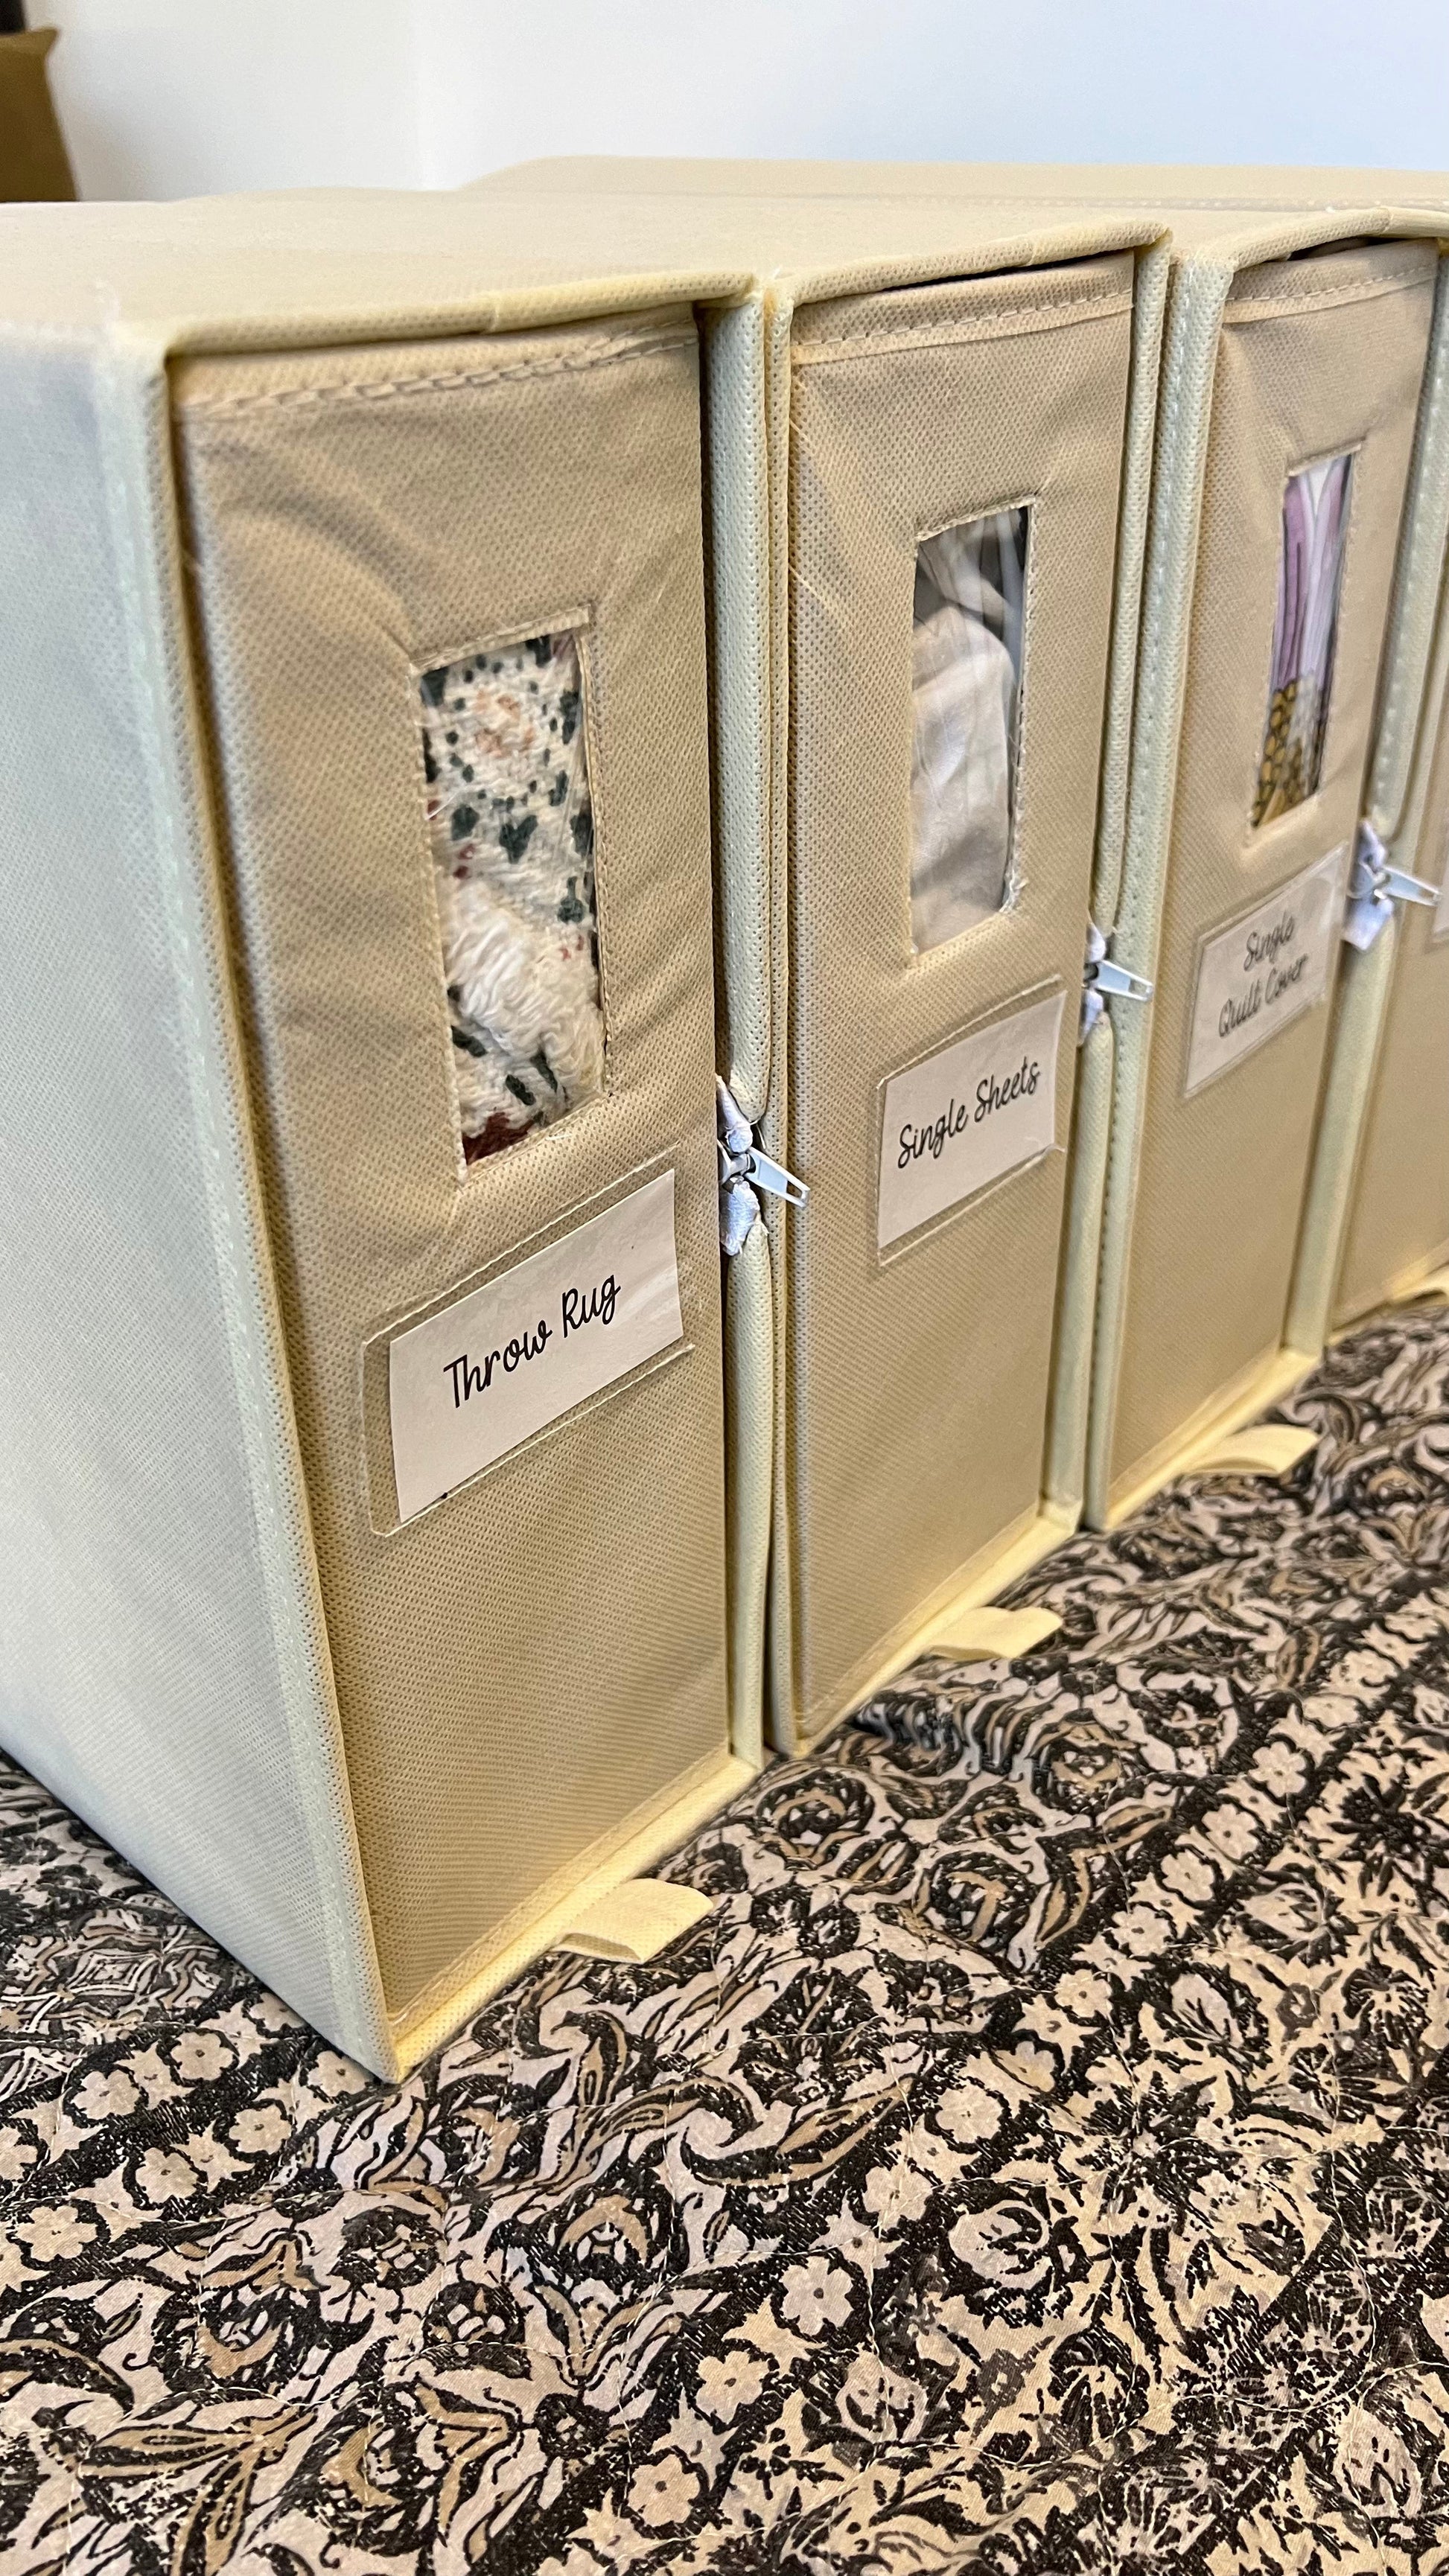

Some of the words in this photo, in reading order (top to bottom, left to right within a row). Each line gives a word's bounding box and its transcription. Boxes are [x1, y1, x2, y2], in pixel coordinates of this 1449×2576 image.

[1243, 910, 1295, 971] Single
[1218, 979, 1261, 1037] Quilt
[1266, 954, 1308, 1004] Cover
[897, 1098, 969, 1169] Single
[974, 1056, 1040, 1123] Sheets
[443, 1320, 552, 1409] Throw
[562, 1274, 621, 1339] Rug
